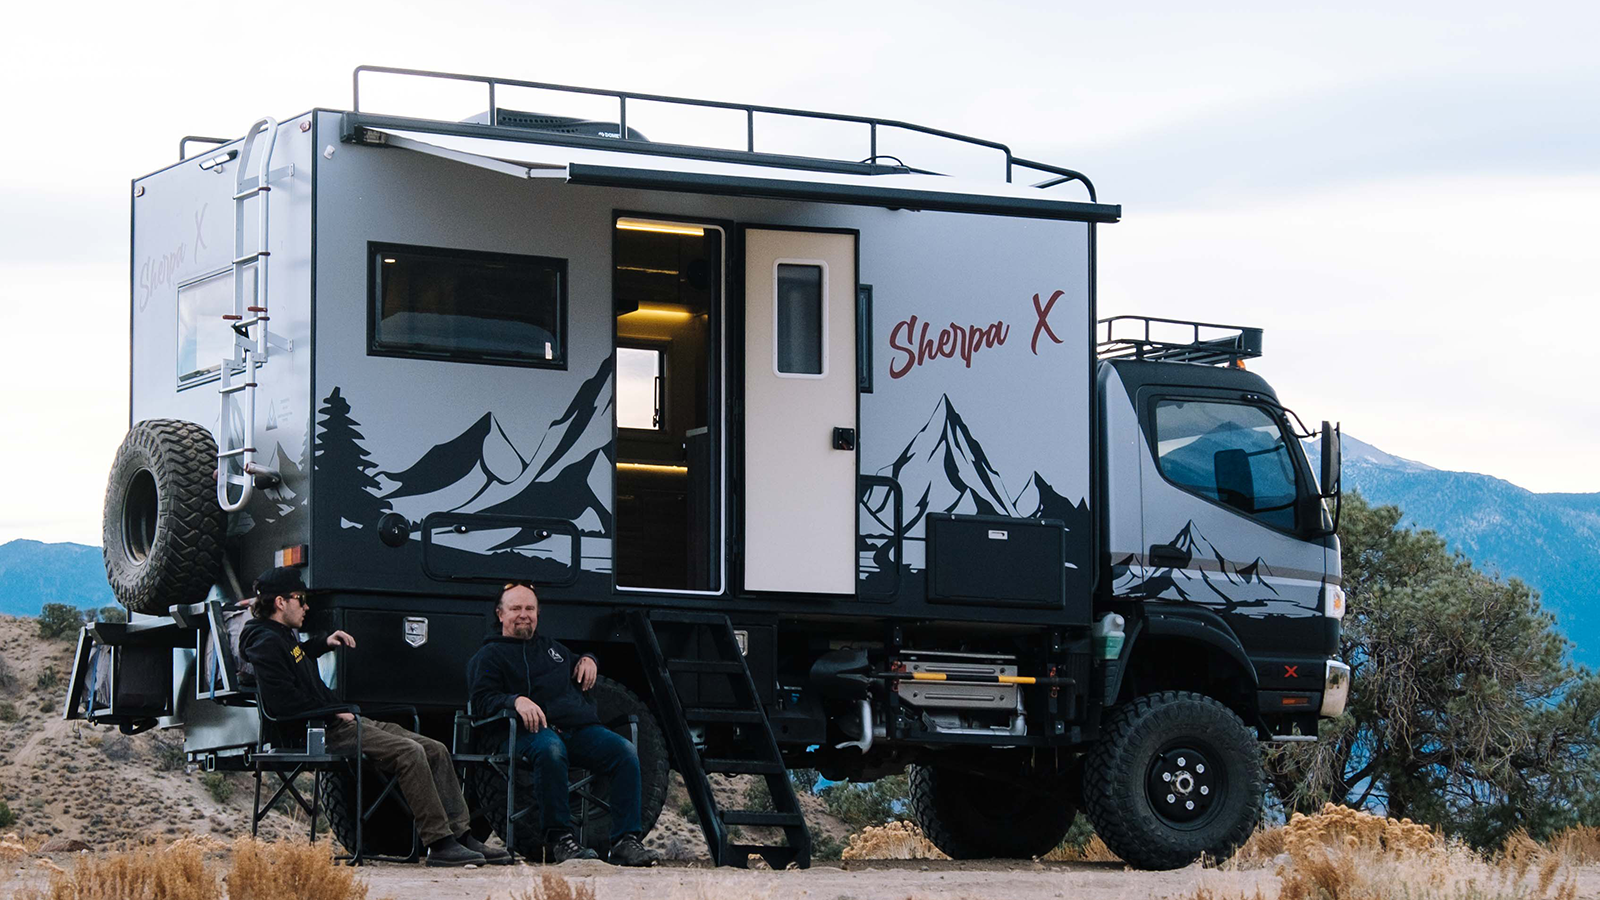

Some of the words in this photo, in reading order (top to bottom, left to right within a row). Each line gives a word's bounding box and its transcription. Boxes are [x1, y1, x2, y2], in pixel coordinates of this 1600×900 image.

[139, 242, 187, 313] Sherpa
[194, 202, 208, 264] X
[889, 314, 1010, 380] Sherpa
[1030, 289, 1066, 356] X
